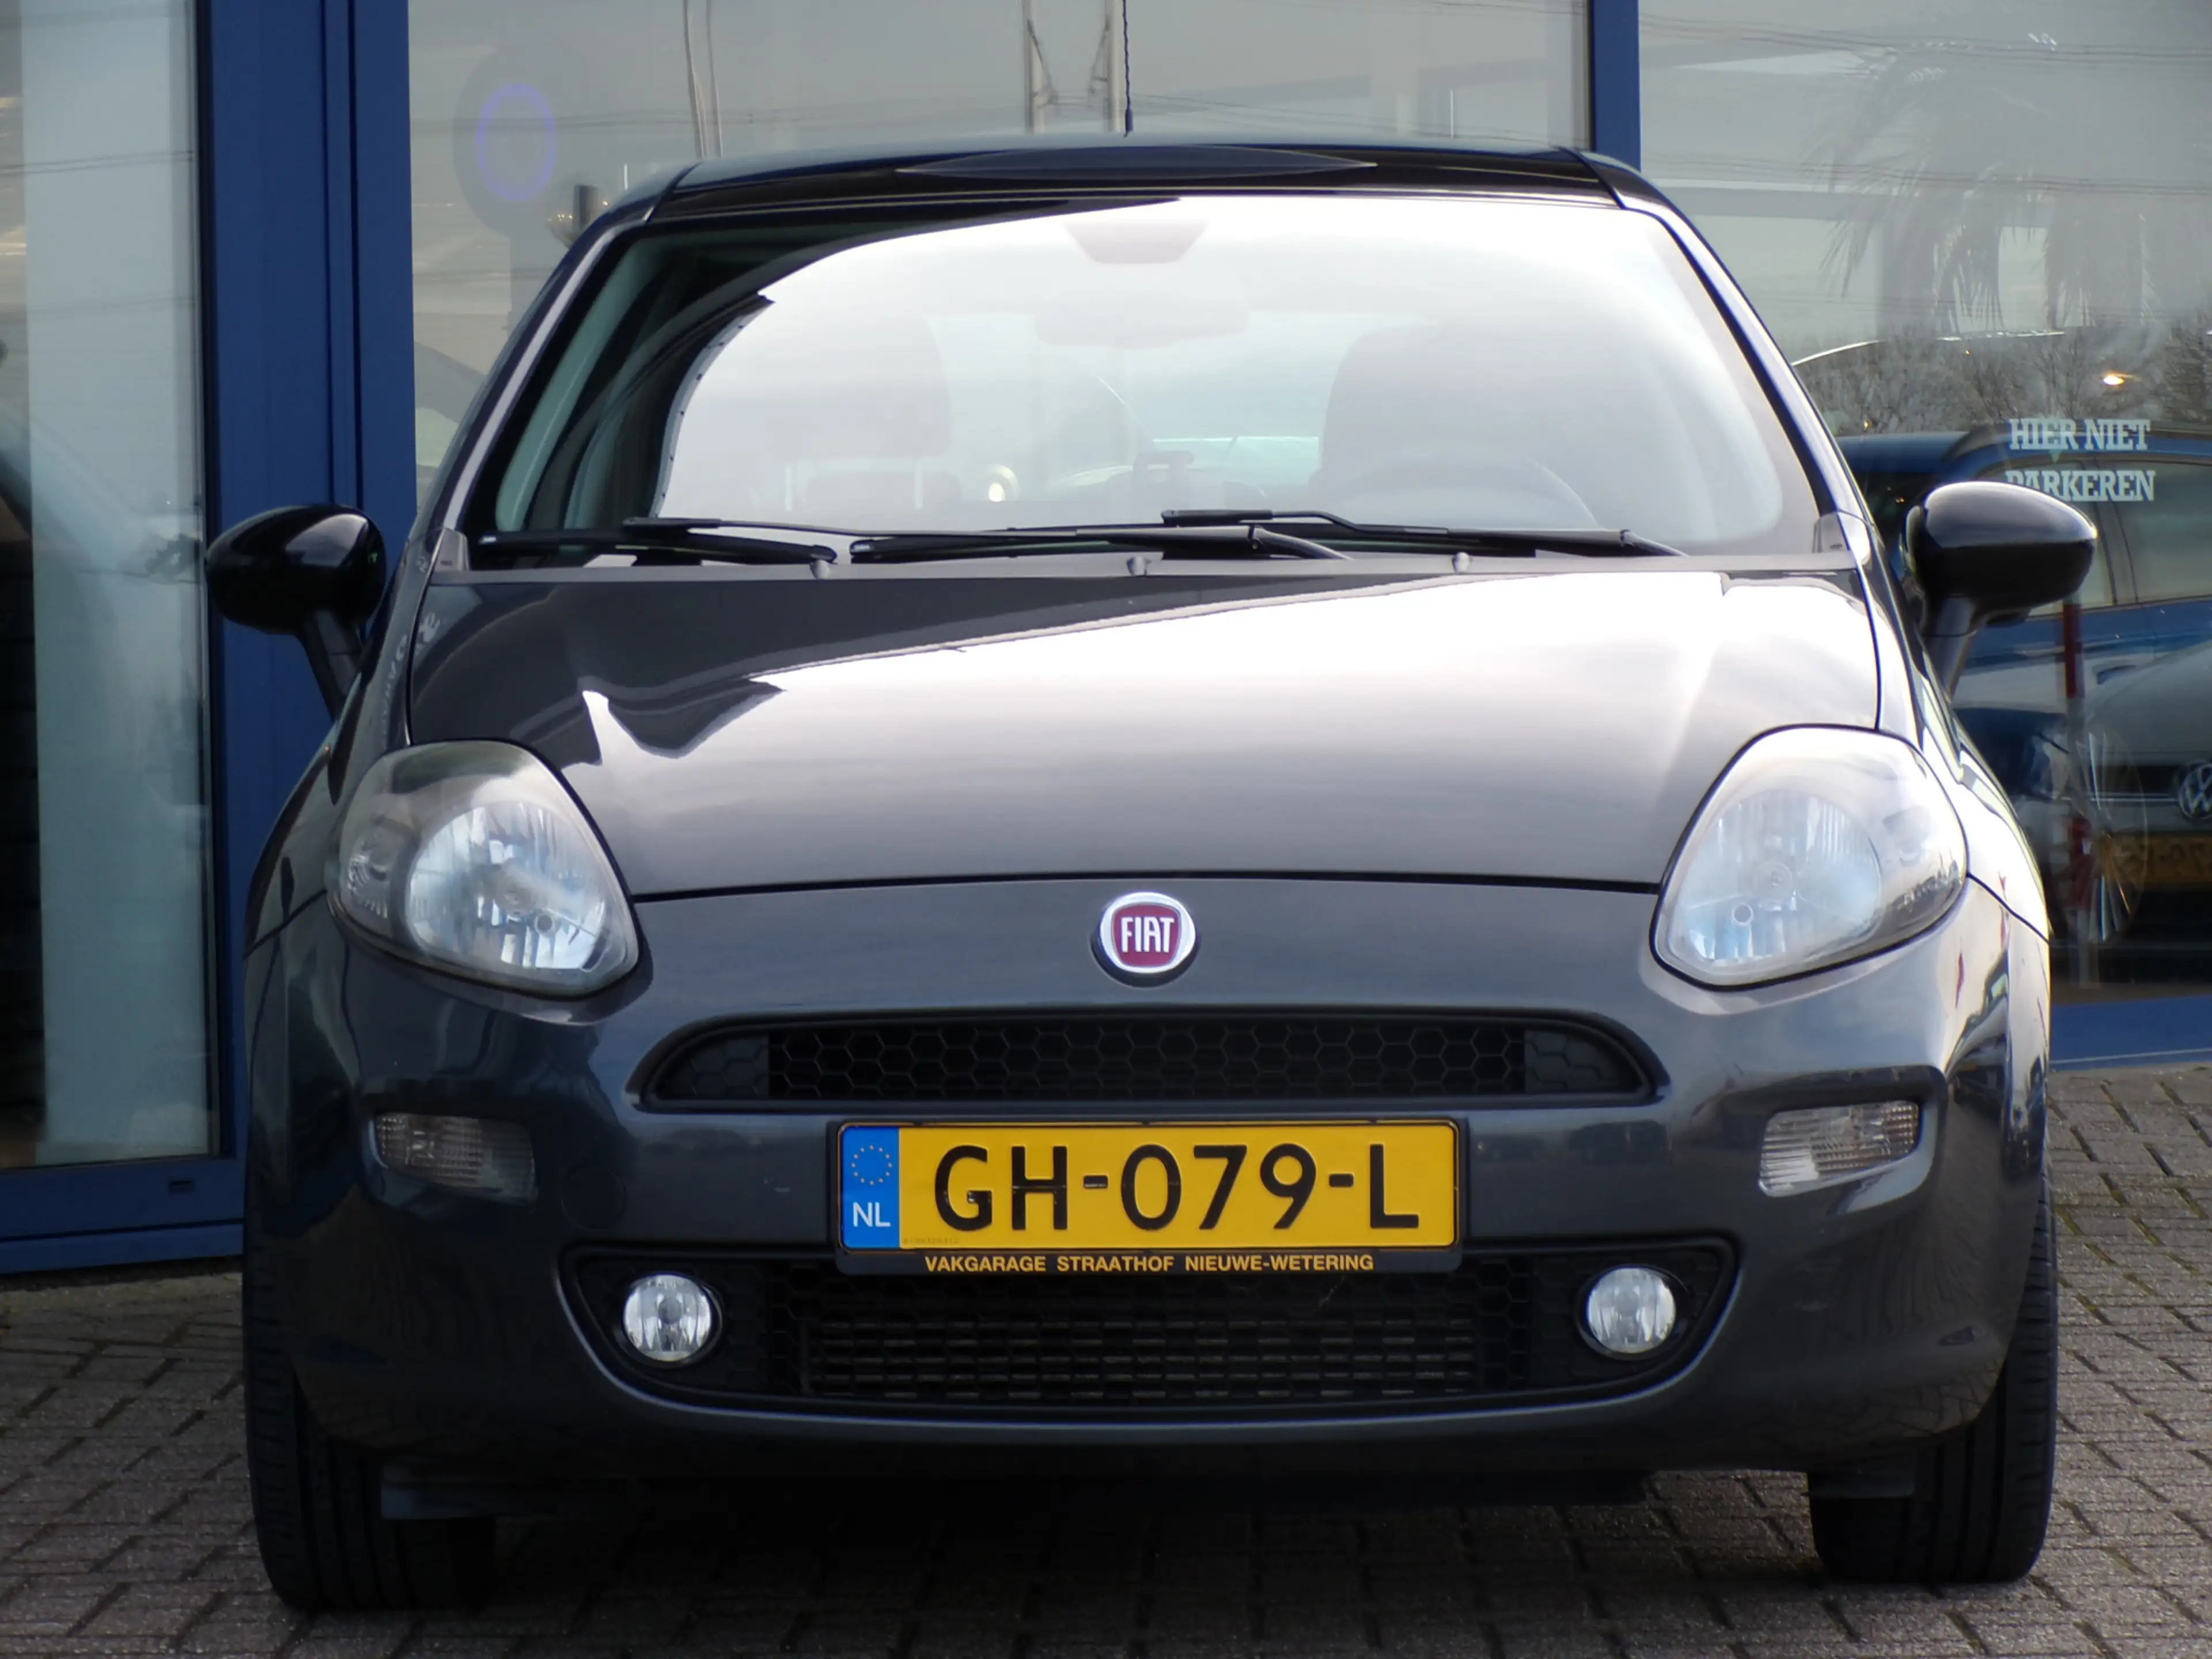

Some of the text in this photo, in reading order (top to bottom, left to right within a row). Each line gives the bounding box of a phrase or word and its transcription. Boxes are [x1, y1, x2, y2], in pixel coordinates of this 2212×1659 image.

[2009, 419, 2150, 450] HIER NIET
[1121, 916, 1175, 953] FIAT
[934, 1143, 1419, 1230] GH-079-L
[851, 1202, 891, 1228] NL
[925, 1255, 1374, 1272] VAKGARAGE STRAATHOF NIEUWE-WETERING
